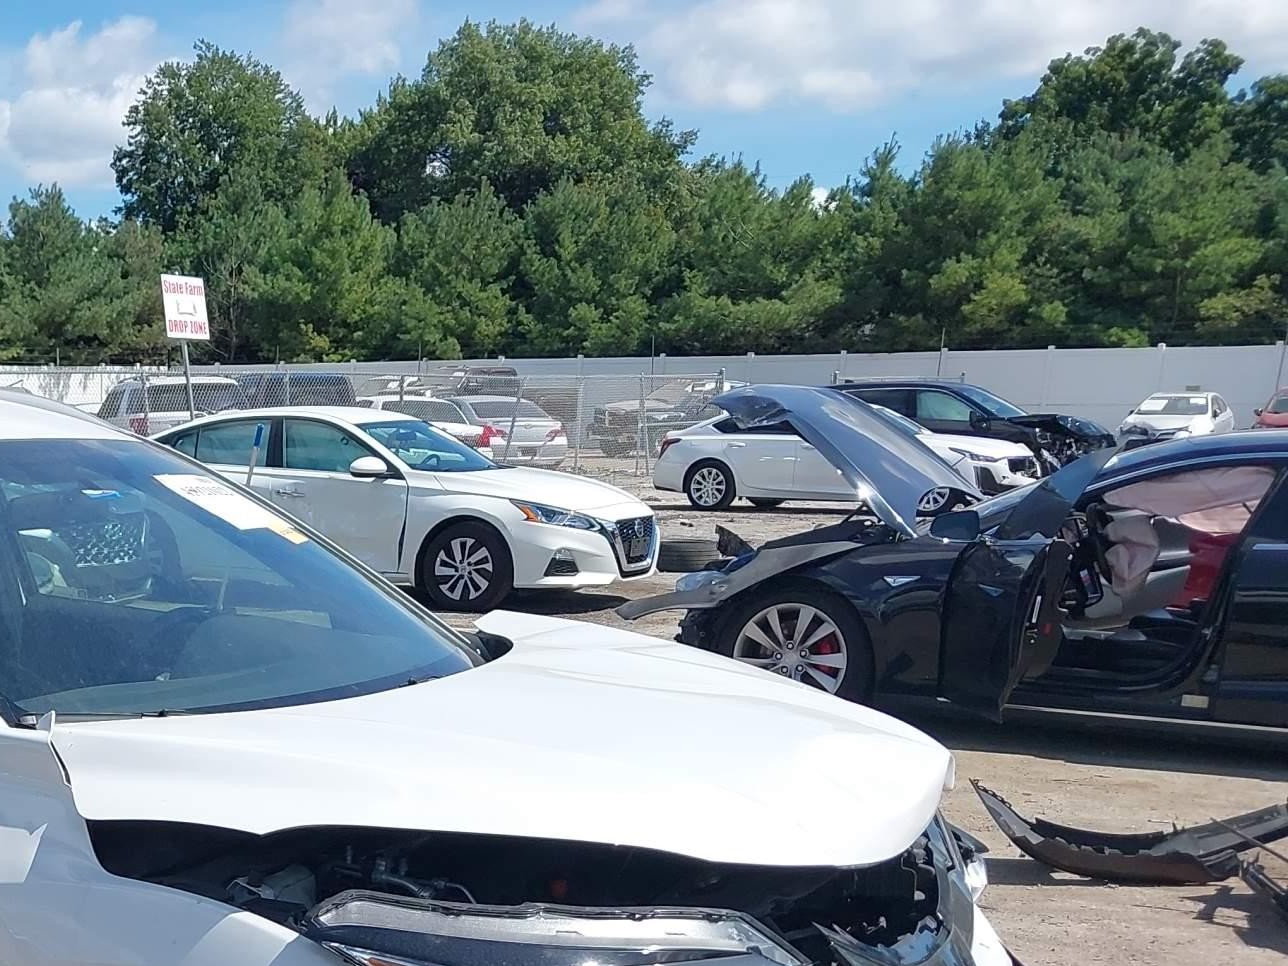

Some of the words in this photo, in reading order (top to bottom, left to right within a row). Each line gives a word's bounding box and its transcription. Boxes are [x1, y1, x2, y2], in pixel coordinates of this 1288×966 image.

[163, 280, 184, 294] State
[185, 282, 203, 296] Farm
[168, 319, 189, 333] DROP
[190, 320, 207, 335] ZONE
